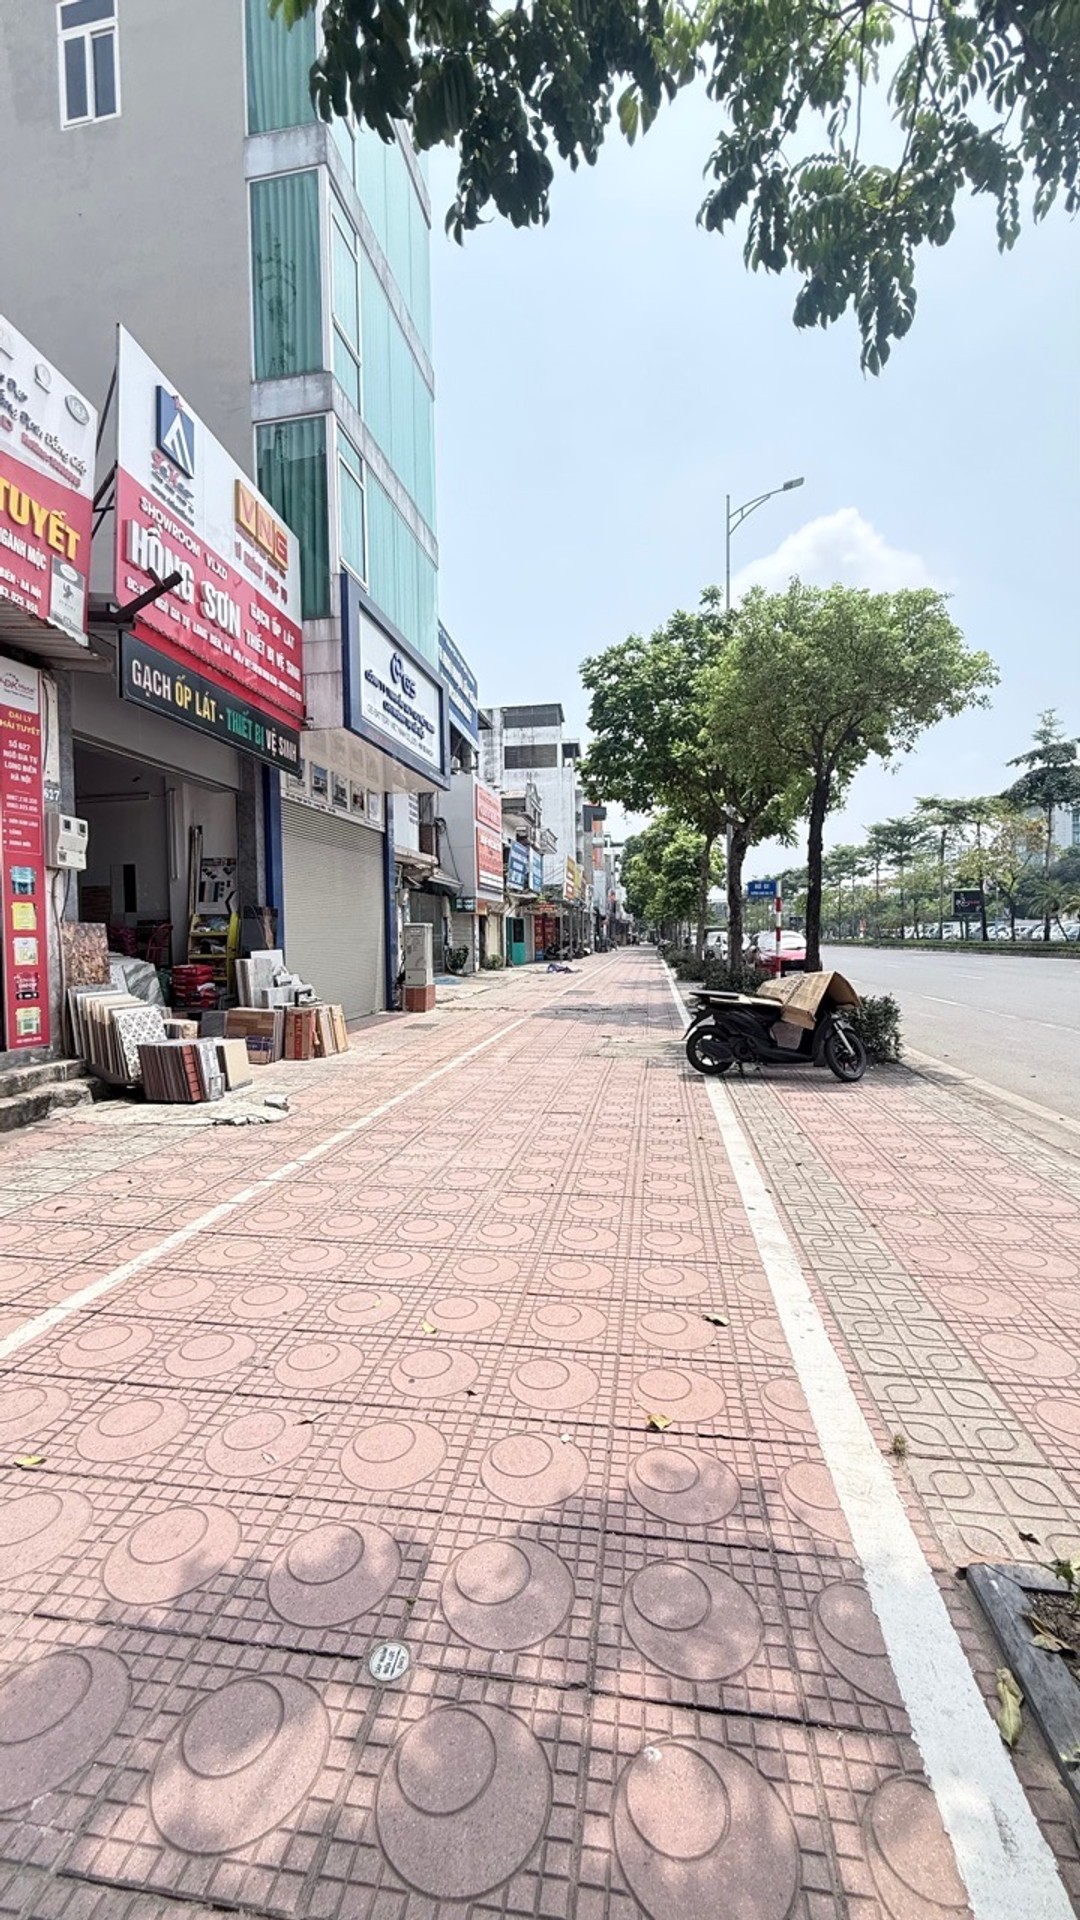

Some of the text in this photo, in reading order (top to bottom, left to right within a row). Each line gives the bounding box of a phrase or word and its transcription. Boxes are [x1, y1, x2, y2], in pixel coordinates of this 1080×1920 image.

[140, 497, 200, 556] SHOWROOM
[127, 519, 195, 605] HỒNG
[201, 580, 241, 639] SƠN
[131, 659, 172, 700] GẠCH
[174, 675, 192, 711] ỐP
[195, 690, 217, 723] LÁT
[225, 706, 253, 741] THIẾT
[254, 723, 265, 751] BỊ
[265, 728, 278, 757] VỆ
[278, 736, 298, 763] SINH
